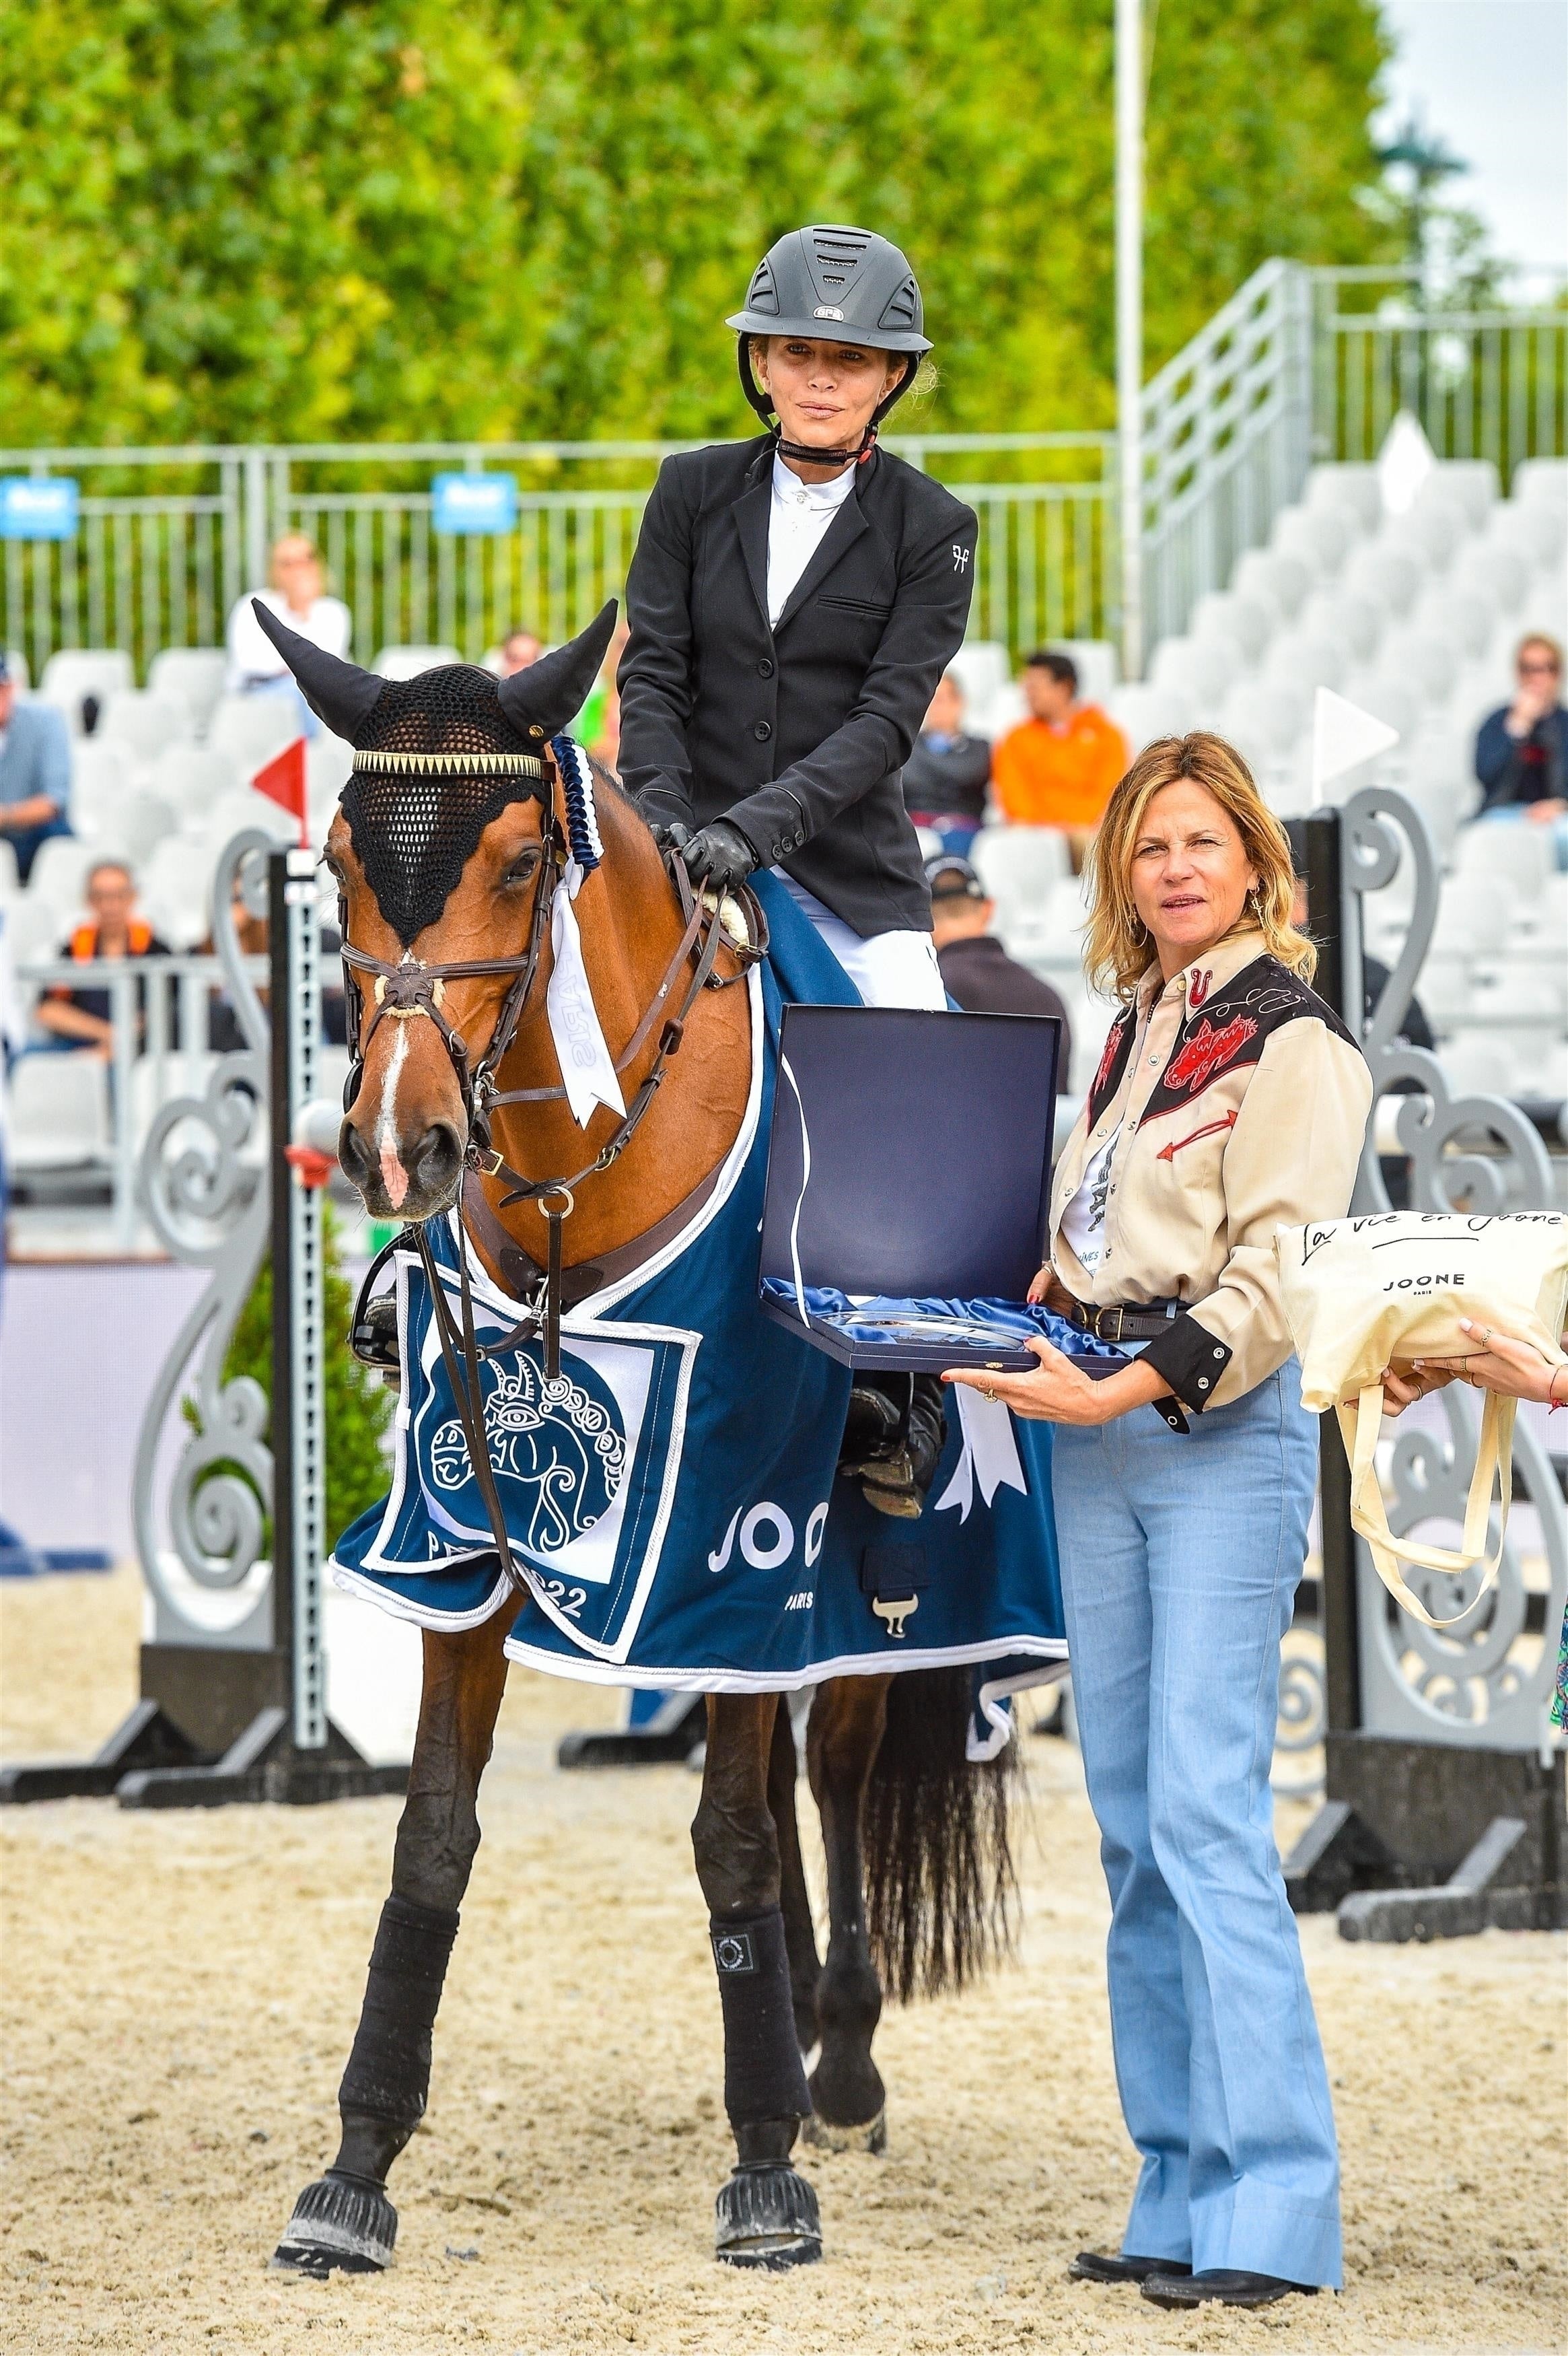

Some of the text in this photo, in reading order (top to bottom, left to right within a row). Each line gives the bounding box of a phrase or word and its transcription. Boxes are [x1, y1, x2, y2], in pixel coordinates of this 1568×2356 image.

[1353, 1215, 1401, 1233] vie
[1421, 1214, 1452, 1222] en
[1383, 1274, 1465, 1291] JOONE
[784, 1591, 814, 1611] PARIS
